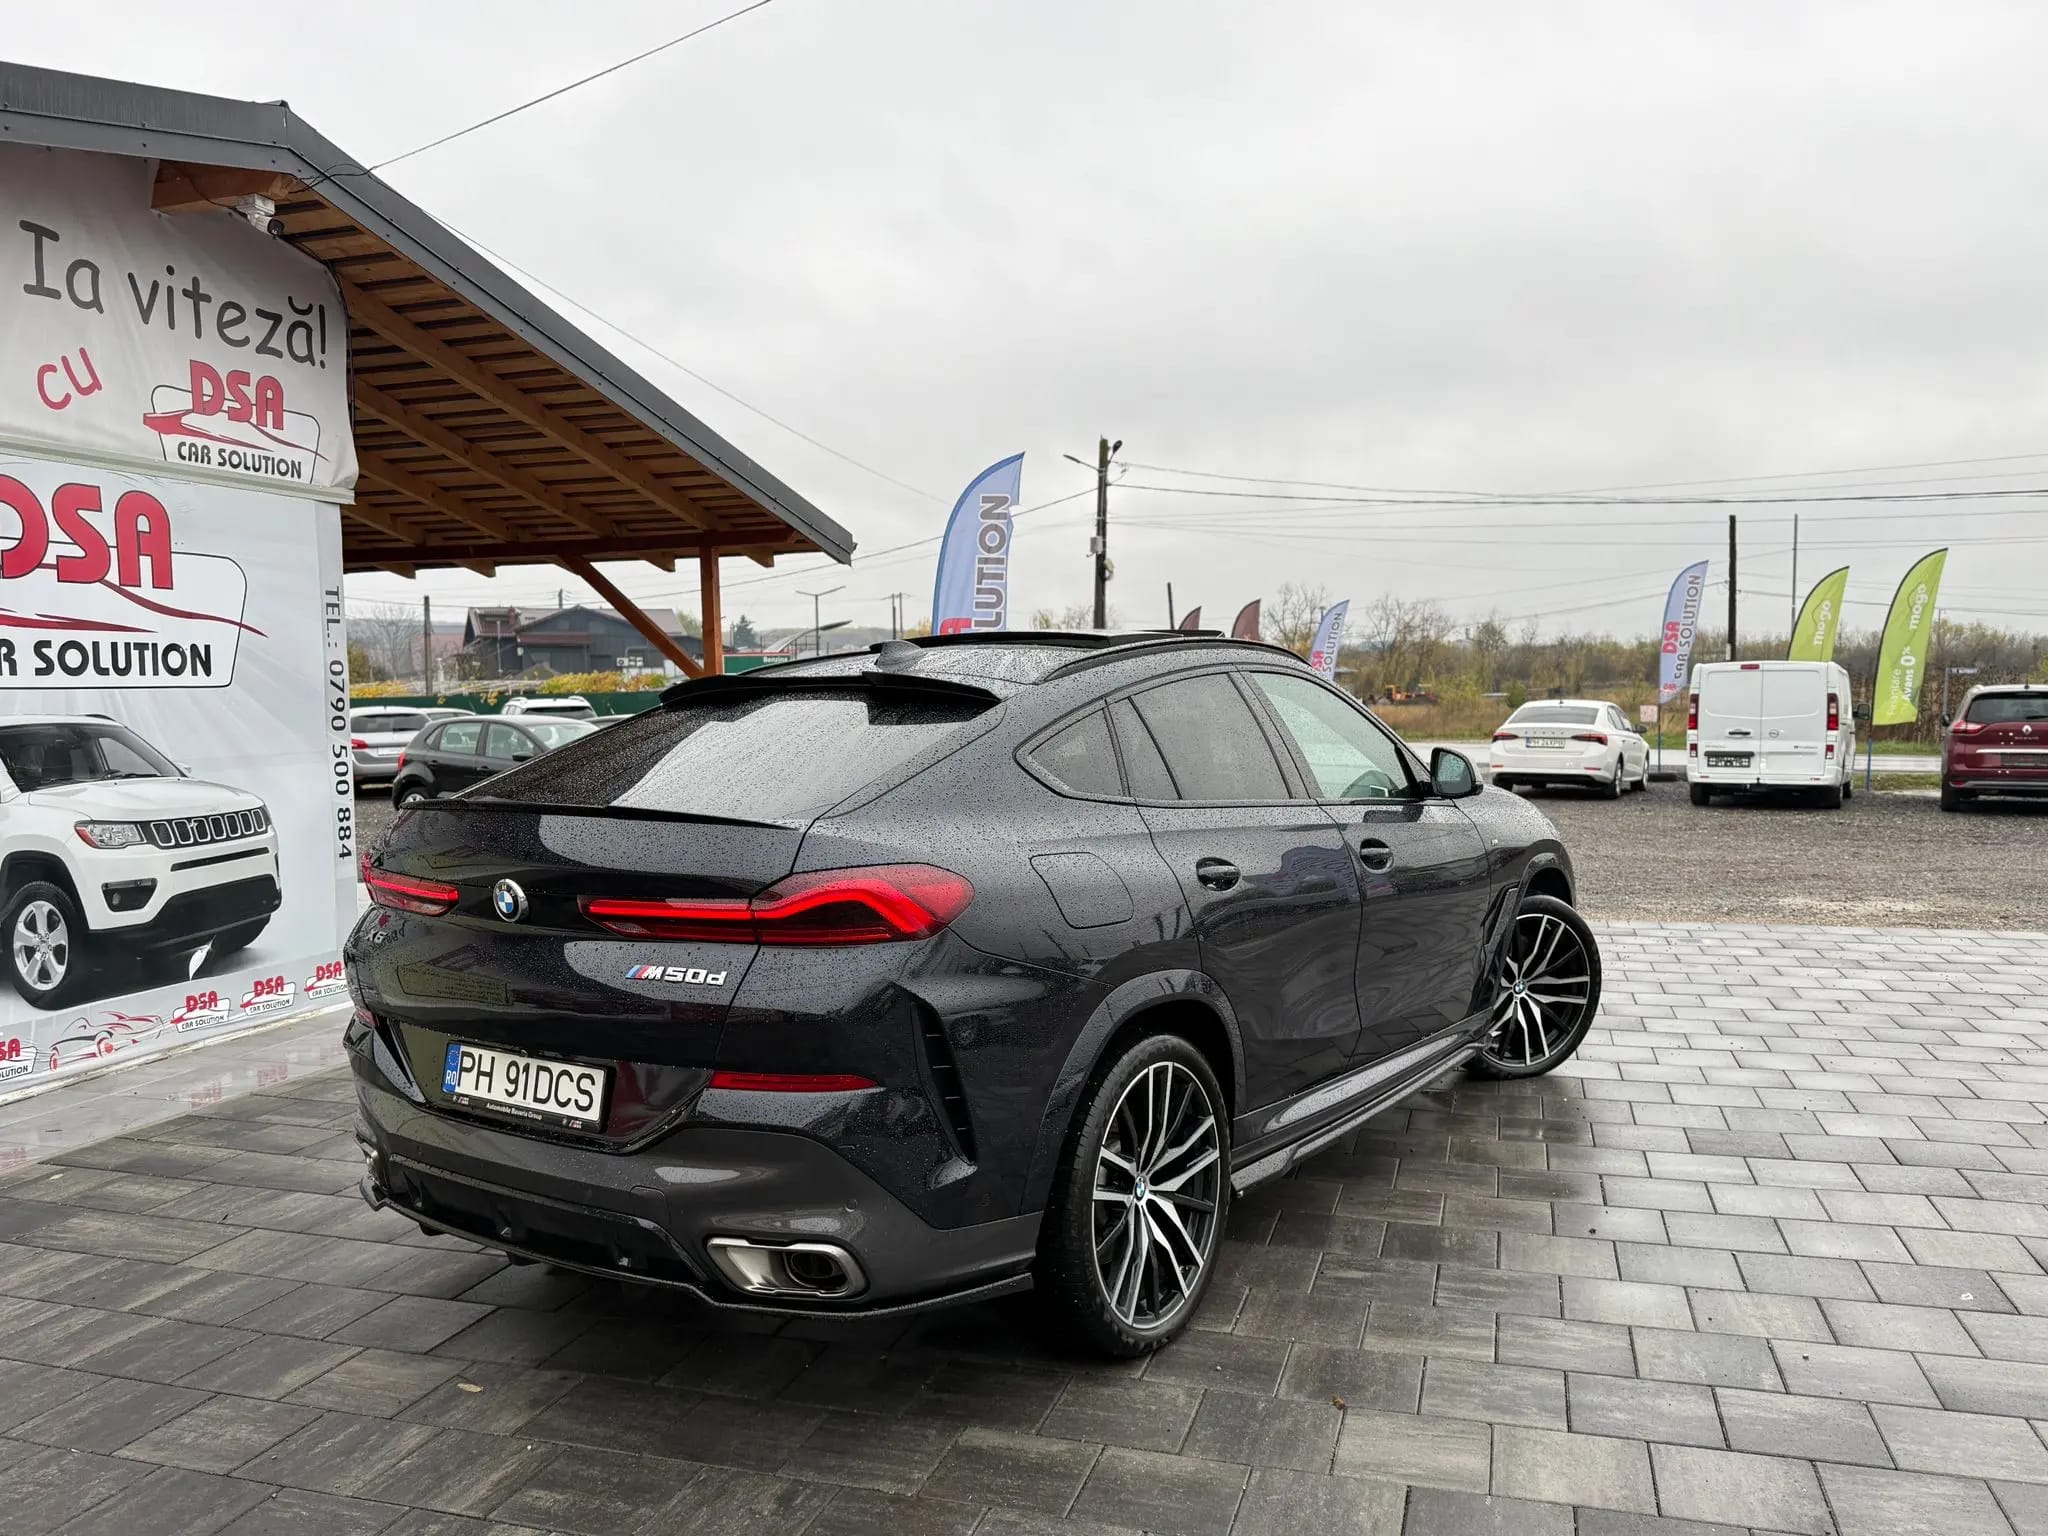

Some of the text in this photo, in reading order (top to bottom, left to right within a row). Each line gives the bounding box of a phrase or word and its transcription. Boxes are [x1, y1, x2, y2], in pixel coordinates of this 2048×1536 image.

[19, 220, 327, 369] Ia viteză!
[37, 347, 103, 411] cu
[189, 359, 284, 431] DSA
[177, 441, 302, 480] CAR SOLUTION
[973, 494, 1011, 629] LUTION
[1814, 601, 1832, 646] mogo
[1908, 583, 1929, 630] mogo
[1323, 612, 1342, 673] SOLUTION
[1663, 620, 1681, 654] DSA
[1674, 575, 1700, 680] CAR SOLUTION
[33, 639, 212, 677] SOLUTION
[329, 659, 347, 732] 0790
[332, 743, 350, 797] 500
[337, 807, 352, 860] 884
[253, 975, 285, 997] DSA
[316, 961, 342, 981] DSA
[185, 991, 218, 1012] DSA
[250, 999, 290, 1014] CAR SOLUTION
[312, 988, 323, 997] CAR
[181, 1015, 225, 1030] CAR SOLUTION
[0, 1065, 28, 1079] LUTION
[445, 1069, 457, 1085] RO
[457, 1050, 496, 1094] PH
[486, 1103, 511, 1114] Automobile
